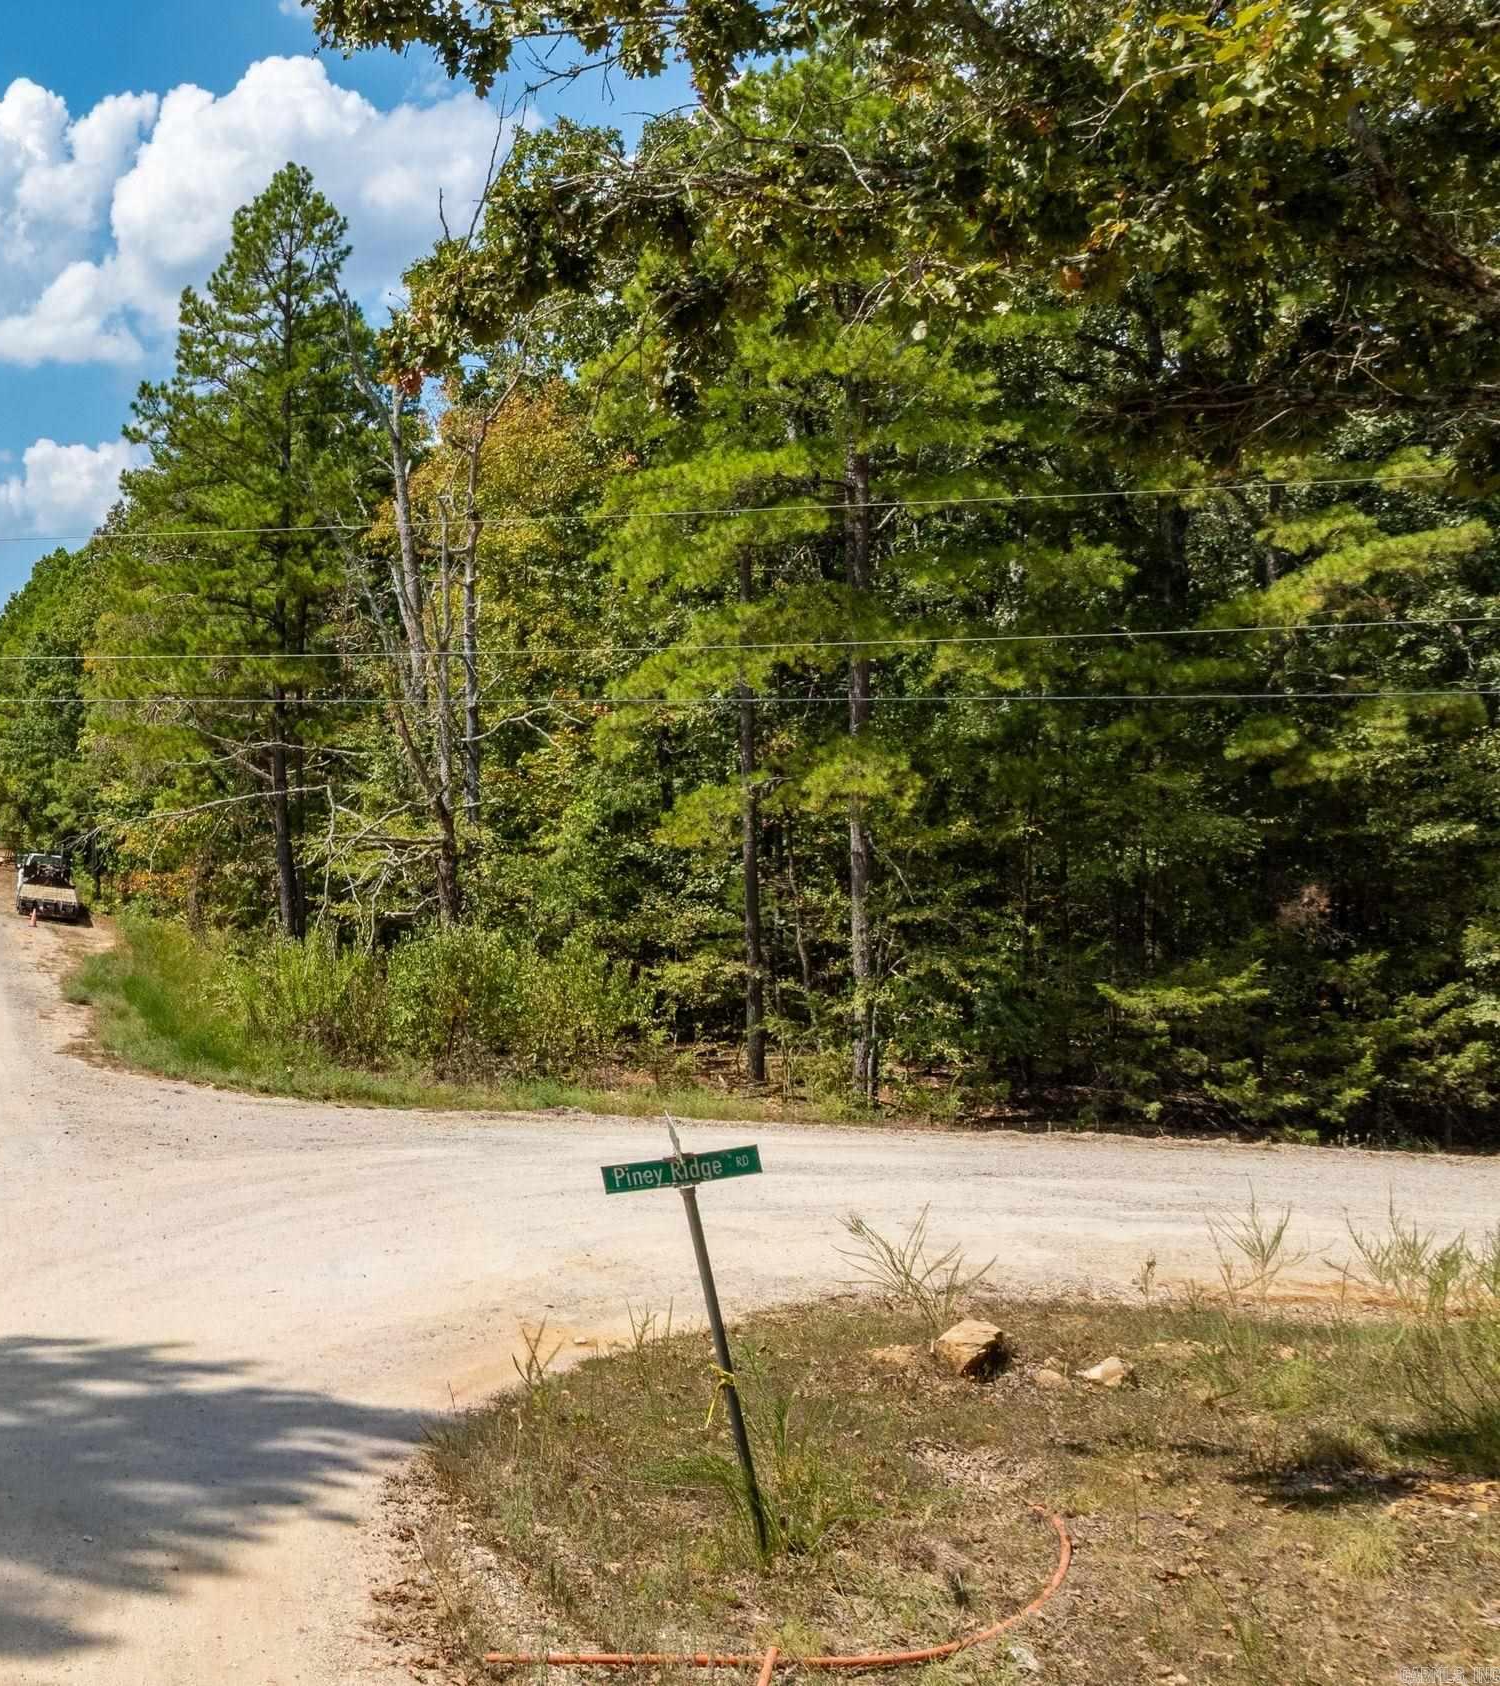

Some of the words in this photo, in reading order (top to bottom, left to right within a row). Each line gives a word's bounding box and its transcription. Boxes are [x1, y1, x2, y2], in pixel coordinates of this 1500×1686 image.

[613, 1166, 662, 1188] Piney
[670, 1157, 723, 1181] Ridge
[735, 1154, 749, 1167] RD
